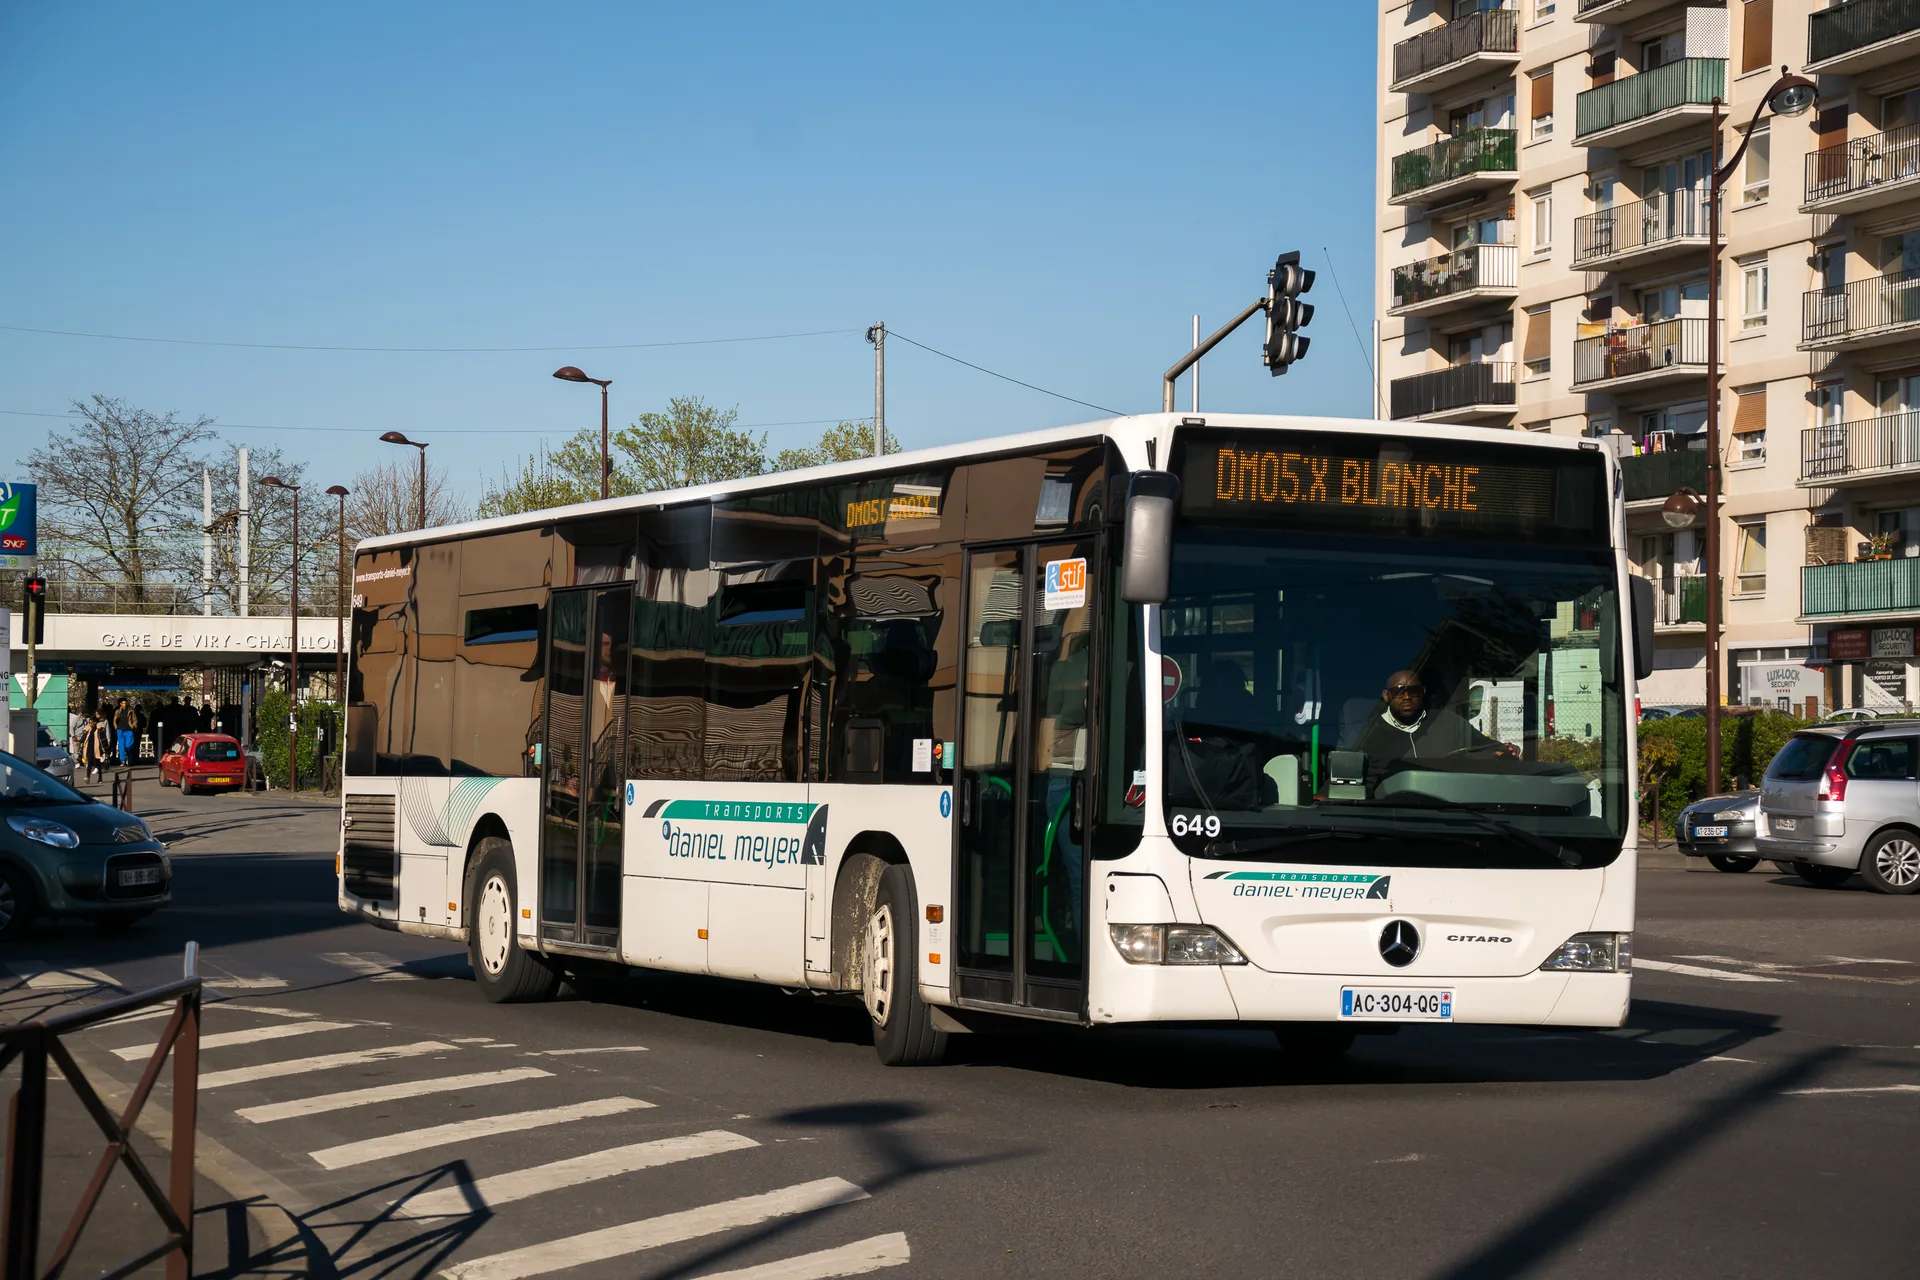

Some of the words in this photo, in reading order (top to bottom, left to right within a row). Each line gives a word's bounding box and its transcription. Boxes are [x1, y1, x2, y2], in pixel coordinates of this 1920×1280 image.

[1341, 460, 1480, 511] BLANCHE
[2, 539, 27, 548] SNCF
[1060, 563, 1085, 590] stif
[102, 634, 151, 648] GARE
[160, 635, 183, 648] DE
[1874, 629, 1912, 644] LUX-LOCK
[1878, 642, 1907, 650] SECURITY
[1766, 668, 1801, 682] LUX-LOCK
[1172, 814, 1221, 837] 649
[733, 834, 801, 869] meyer
[1301, 886, 1366, 902] meyer
[1446, 935, 1513, 943] CITARO
[1353, 994, 1439, 1013] AC-304-QG
[1441, 1006, 1450, 1015] 91
